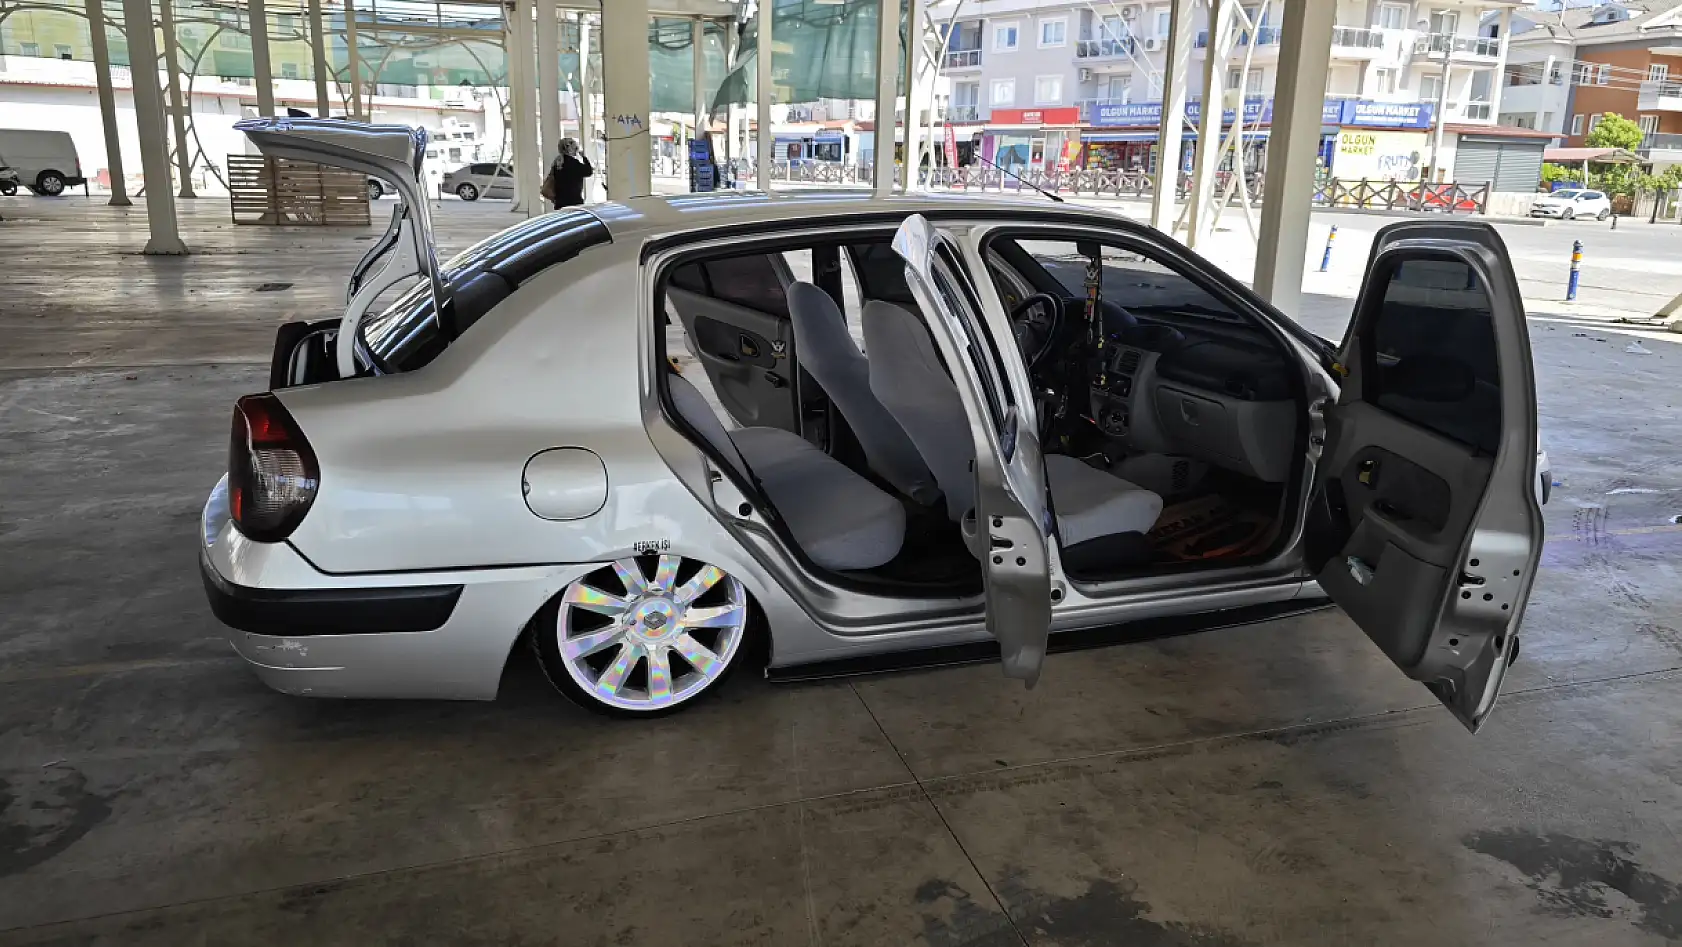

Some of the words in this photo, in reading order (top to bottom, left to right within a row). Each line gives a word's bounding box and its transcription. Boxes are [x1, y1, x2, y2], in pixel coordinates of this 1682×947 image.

[1386, 106, 1421, 117] MARKET
[1341, 134, 1376, 146] OLGUN
[1340, 146, 1374, 155] MARKET
